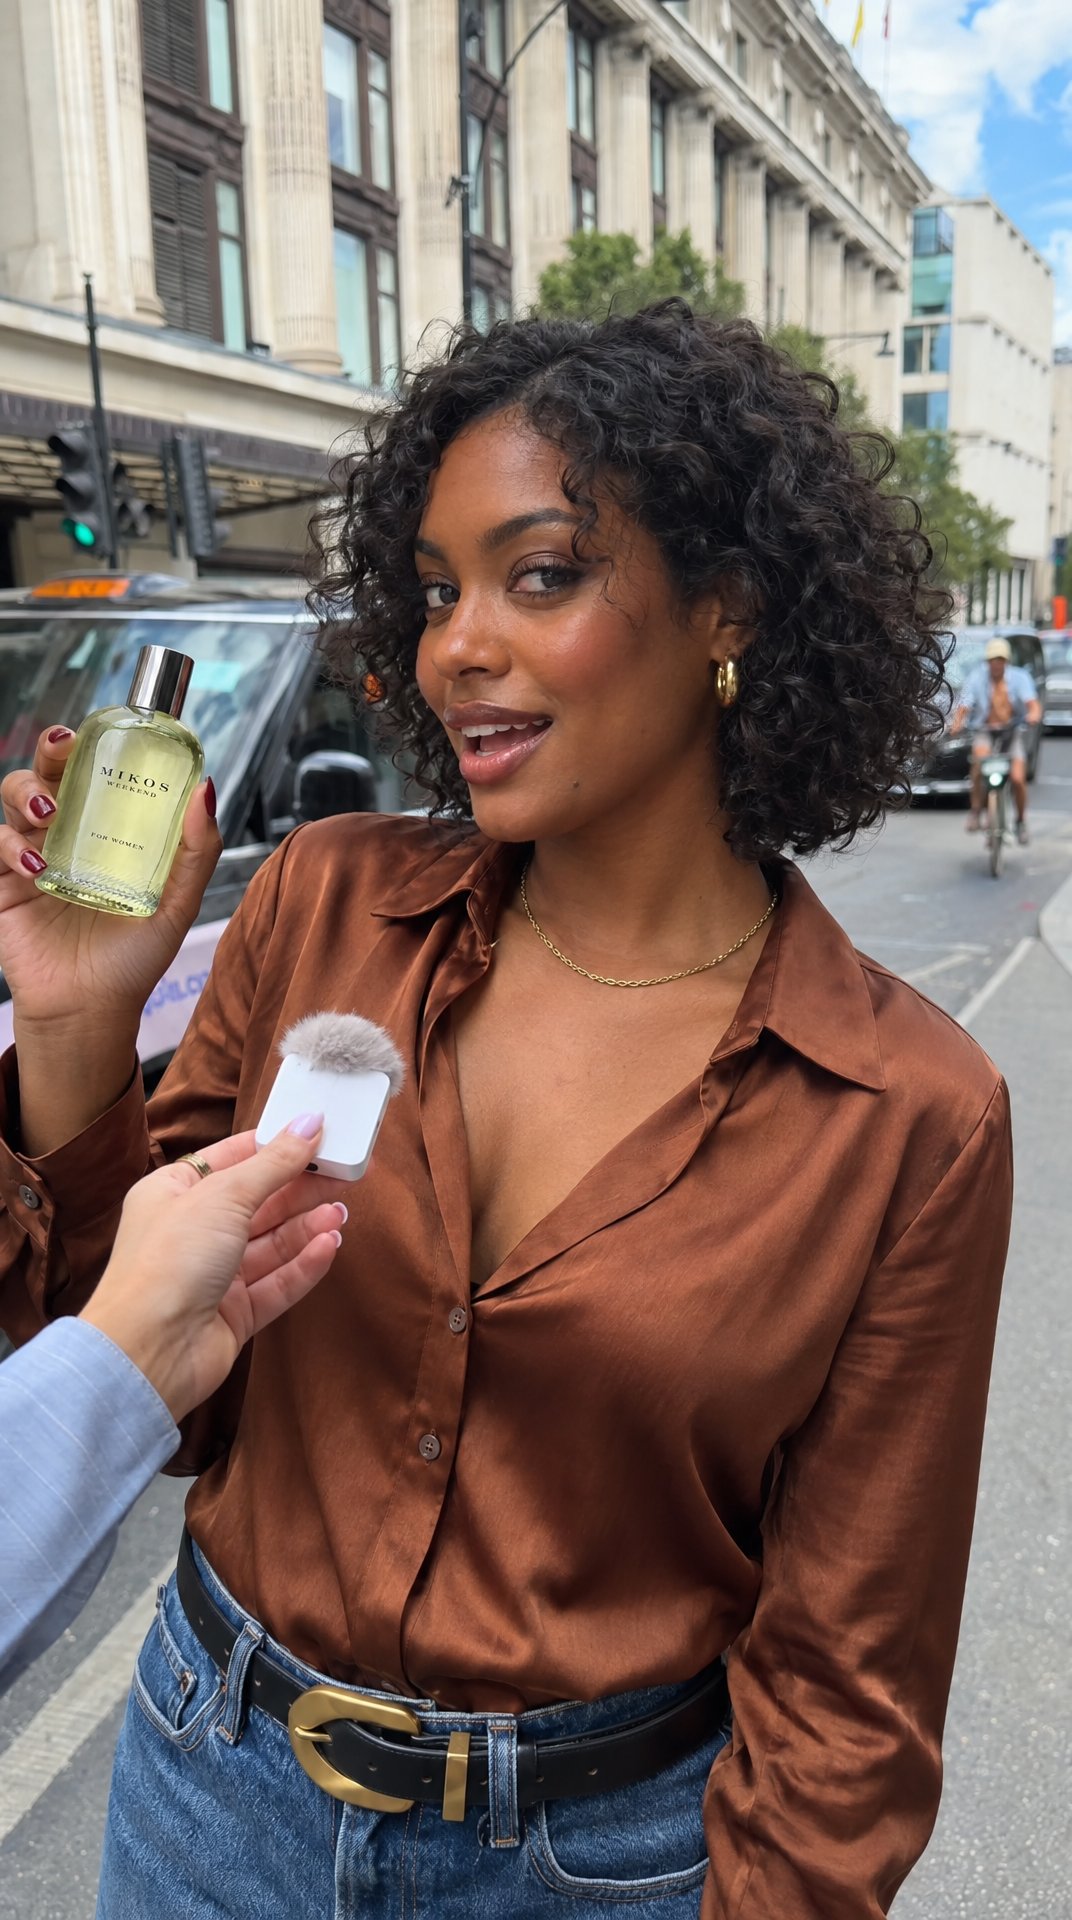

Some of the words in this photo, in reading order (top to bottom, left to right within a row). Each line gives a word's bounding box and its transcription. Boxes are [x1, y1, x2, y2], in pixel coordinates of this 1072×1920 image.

[100, 766, 170, 793] MIKOS
[107, 780, 157, 798] WEEKEND
[90, 831, 108, 841] FOR
[111, 837, 144, 851] WOMEN
